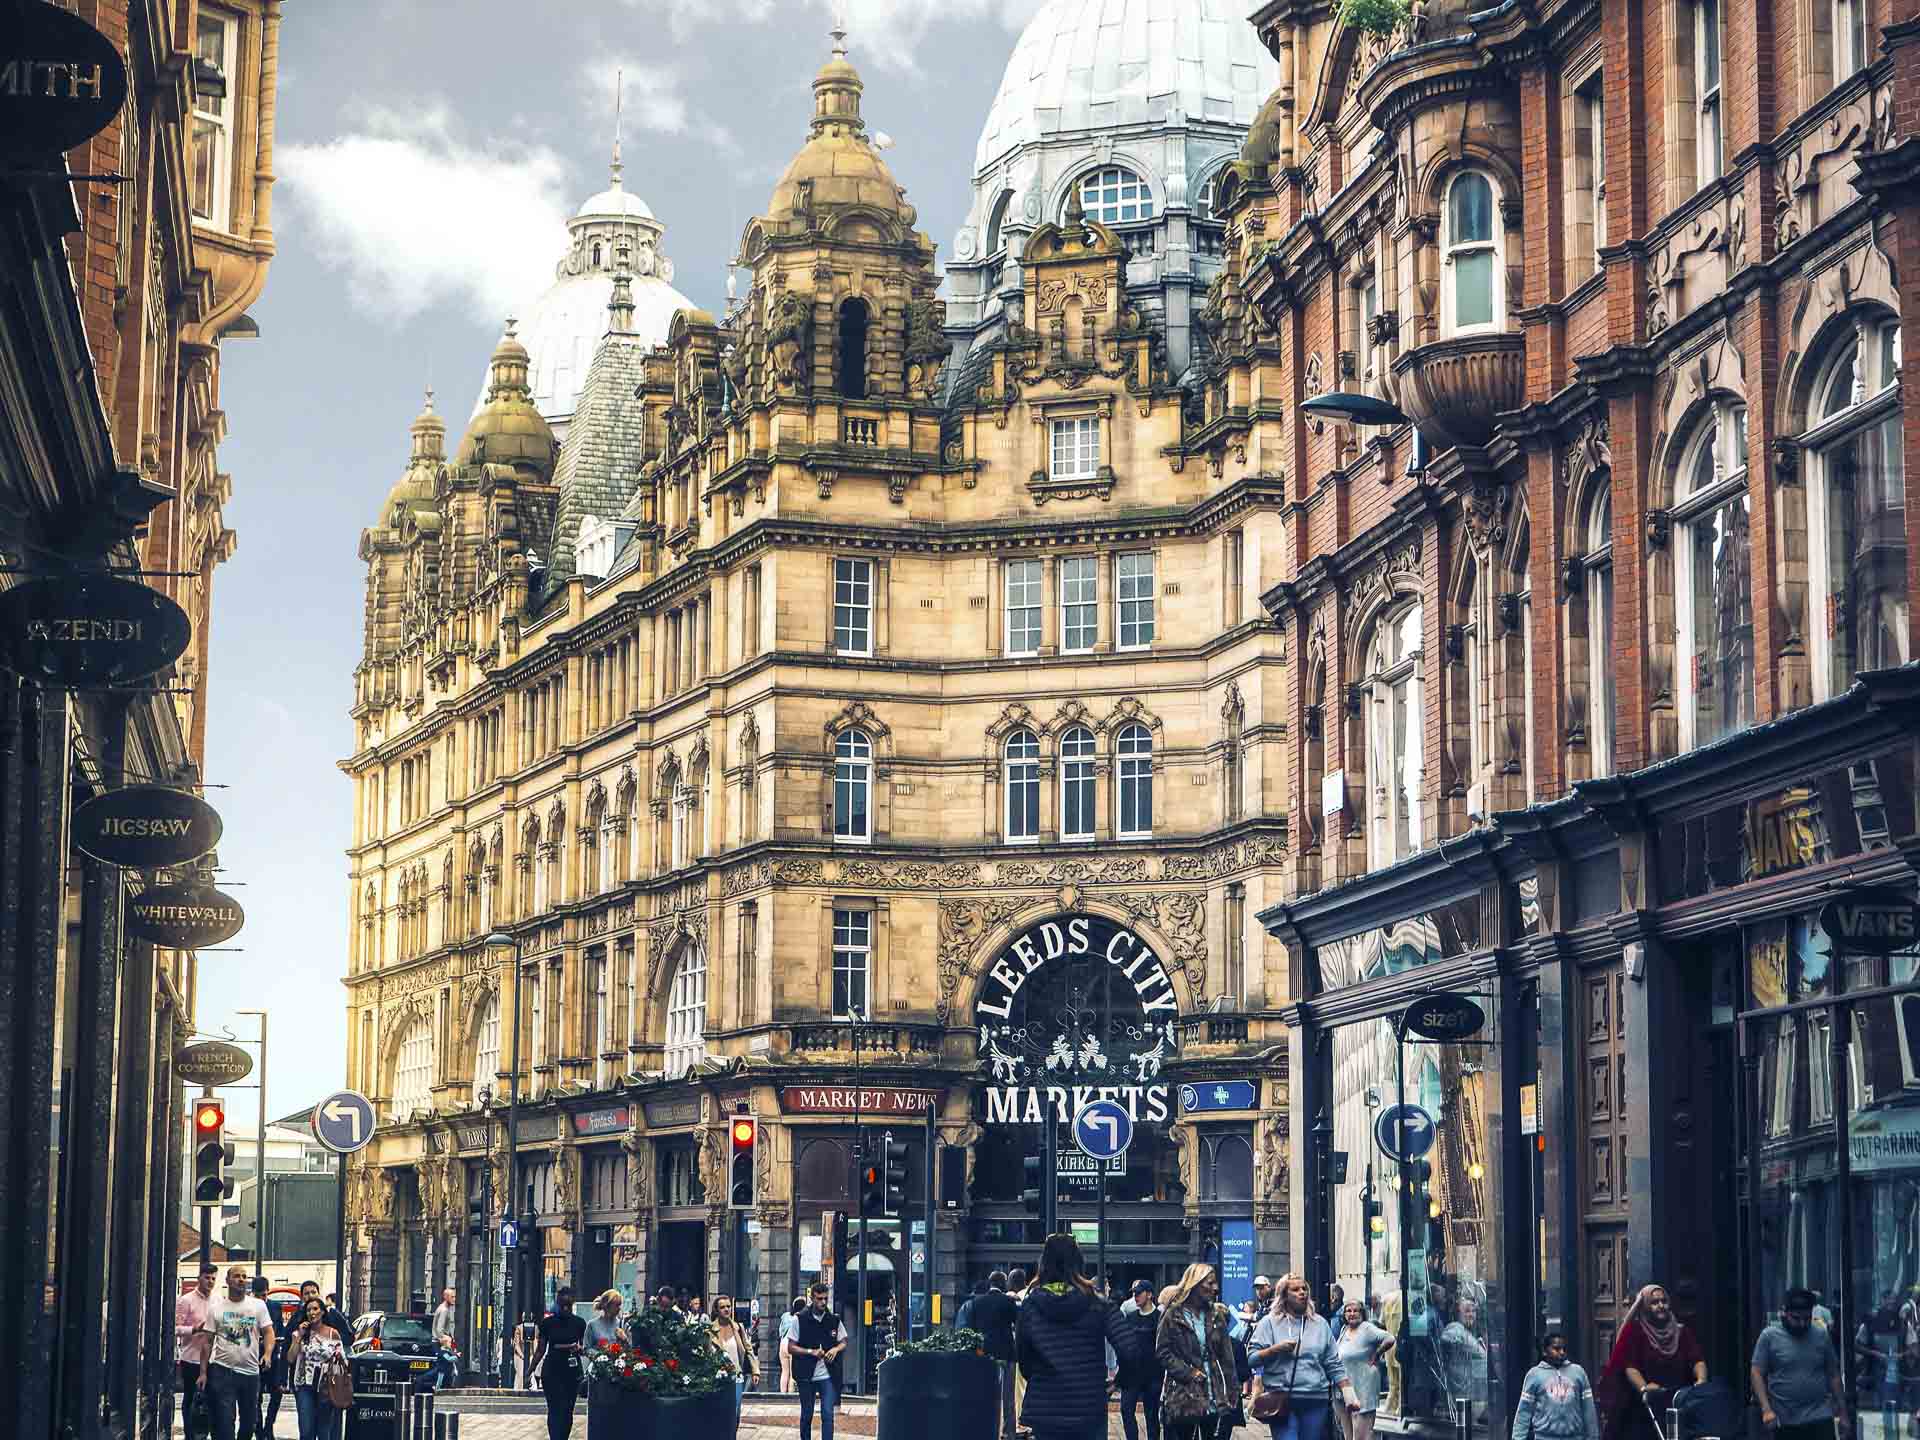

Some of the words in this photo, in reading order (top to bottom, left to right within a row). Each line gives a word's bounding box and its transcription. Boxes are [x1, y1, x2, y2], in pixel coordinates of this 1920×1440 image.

[26, 619, 143, 641] AZENDI
[101, 818, 193, 837] JIGSAW
[133, 905, 238, 922] WHITEWALL
[976, 918, 1089, 1020] LEEDS
[1105, 930, 1178, 1015] CITY
[178, 1062, 245, 1074] CONNECTION
[799, 1090, 885, 1110] MARKET
[1056, 1155, 1121, 1170] KIRKGTE
[1223, 1237, 1253, 1246] welcome
